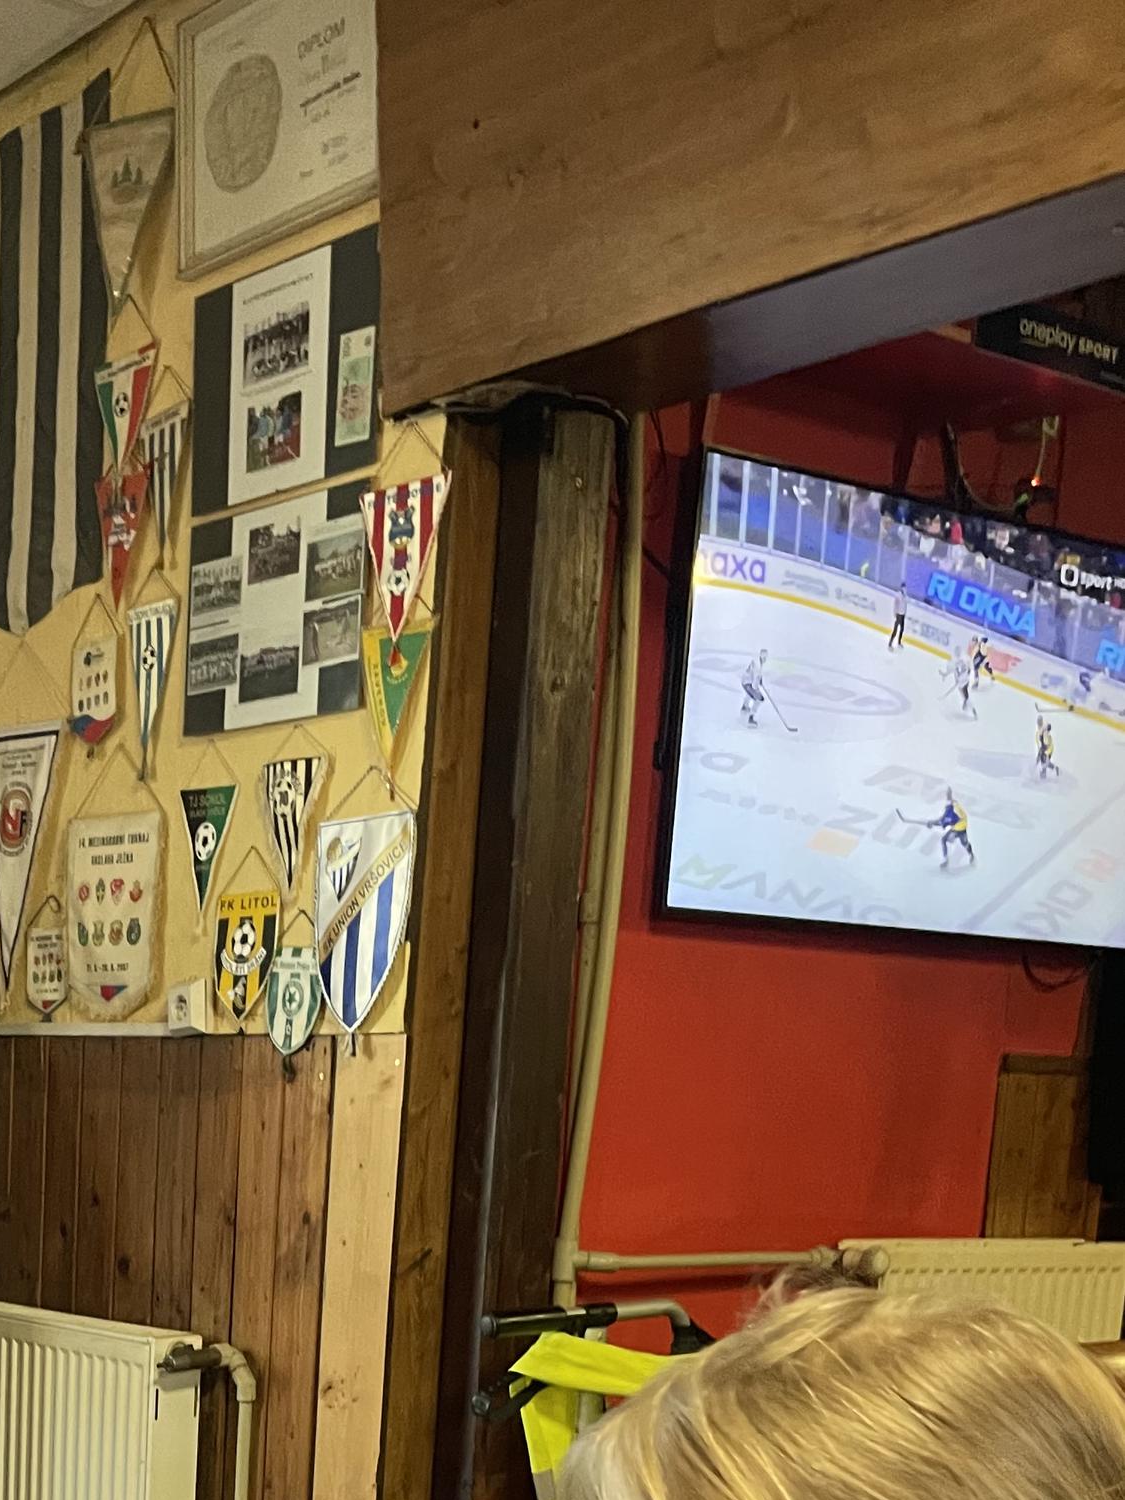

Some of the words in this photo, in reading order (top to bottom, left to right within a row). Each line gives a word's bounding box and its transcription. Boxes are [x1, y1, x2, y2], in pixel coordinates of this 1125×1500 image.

[1019, 318, 1078, 356] oneplay
[1078, 336, 1119, 365] SPORT
[958, 585, 1036, 639] OKNA
[220, 898, 235, 912] FK
[240, 895, 277, 911] LITOL
[331, 898, 361, 935] UNION
